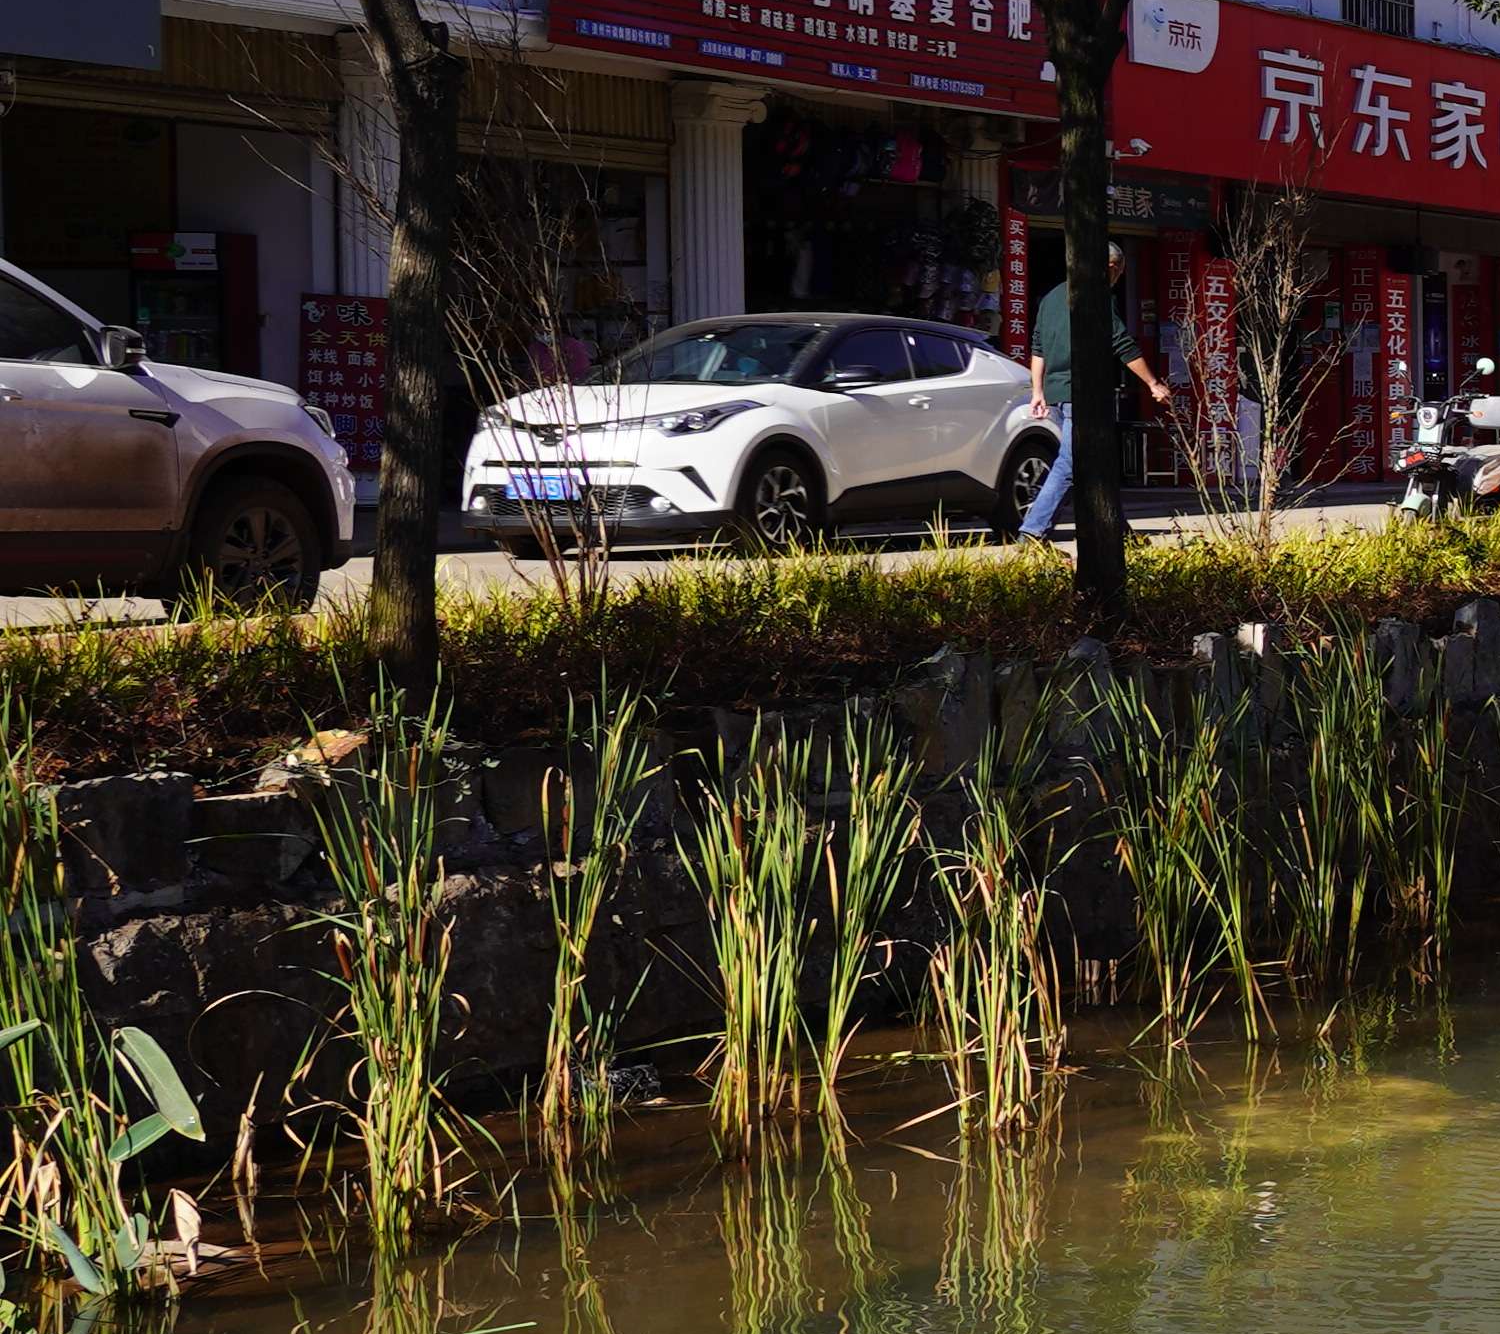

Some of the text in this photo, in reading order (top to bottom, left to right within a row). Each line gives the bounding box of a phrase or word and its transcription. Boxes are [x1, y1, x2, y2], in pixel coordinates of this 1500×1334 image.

[1168, 20, 1202, 51] 京东
[1009, 219, 1026, 335] 买家电逛京东
[305, 348, 340, 366] 米线
[304, 391, 375, 412] 各种炒饭
